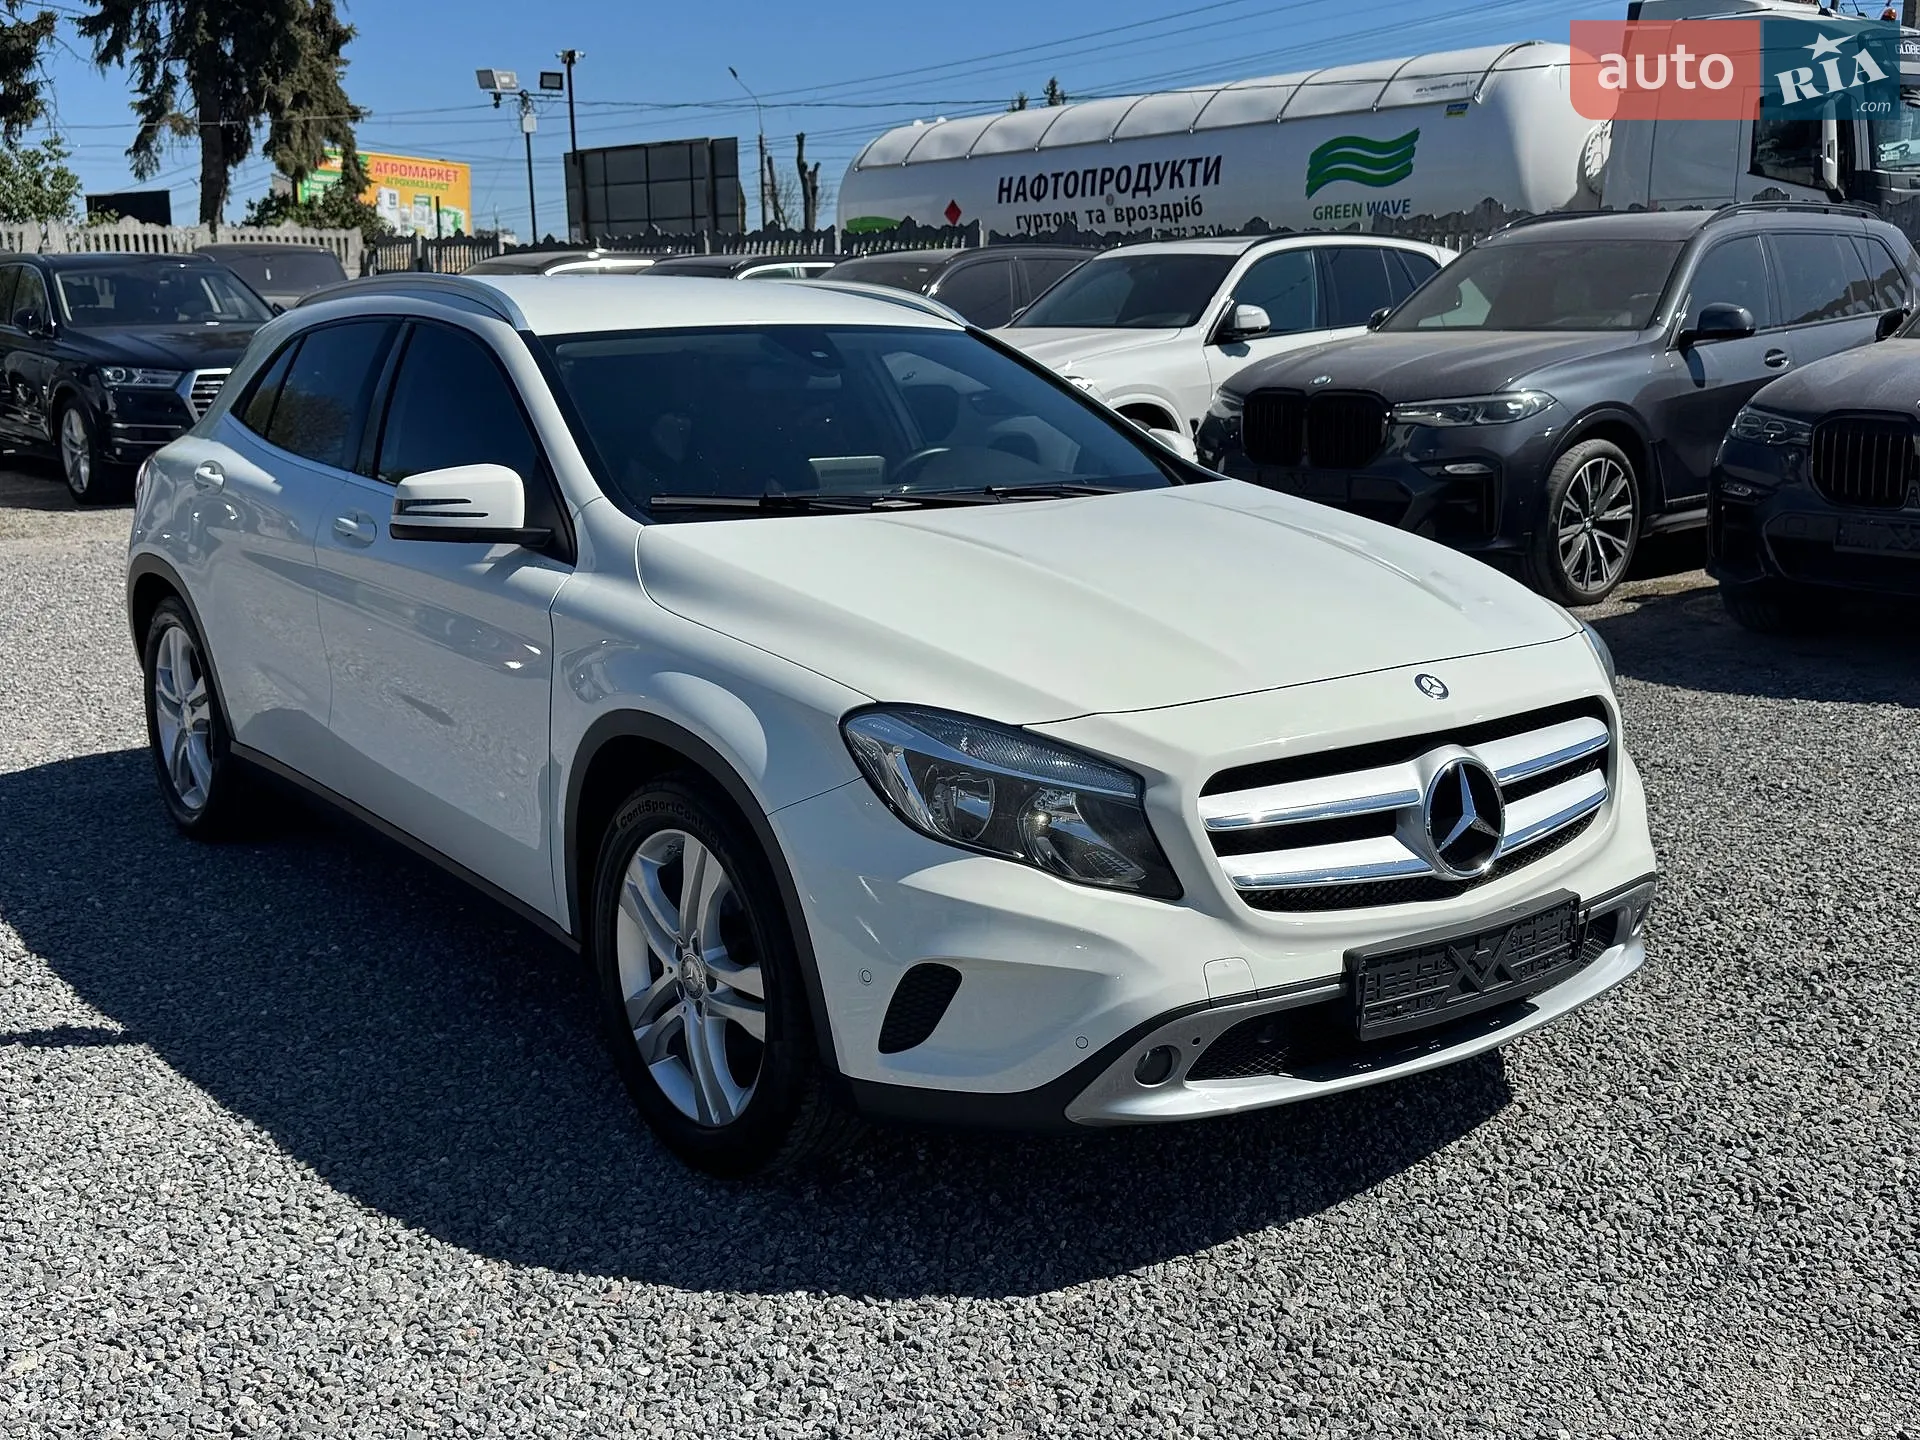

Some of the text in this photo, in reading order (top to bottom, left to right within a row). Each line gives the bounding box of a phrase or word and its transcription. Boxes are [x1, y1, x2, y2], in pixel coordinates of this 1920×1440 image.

[375, 161, 459, 183] АГРОМАРКЕТ
[997, 155, 1222, 204] НАФТОПРОДУКТИ
[1016, 195, 1204, 233] гуртом та вроздріб
[1313, 198, 1411, 220] GREEN WAVE
